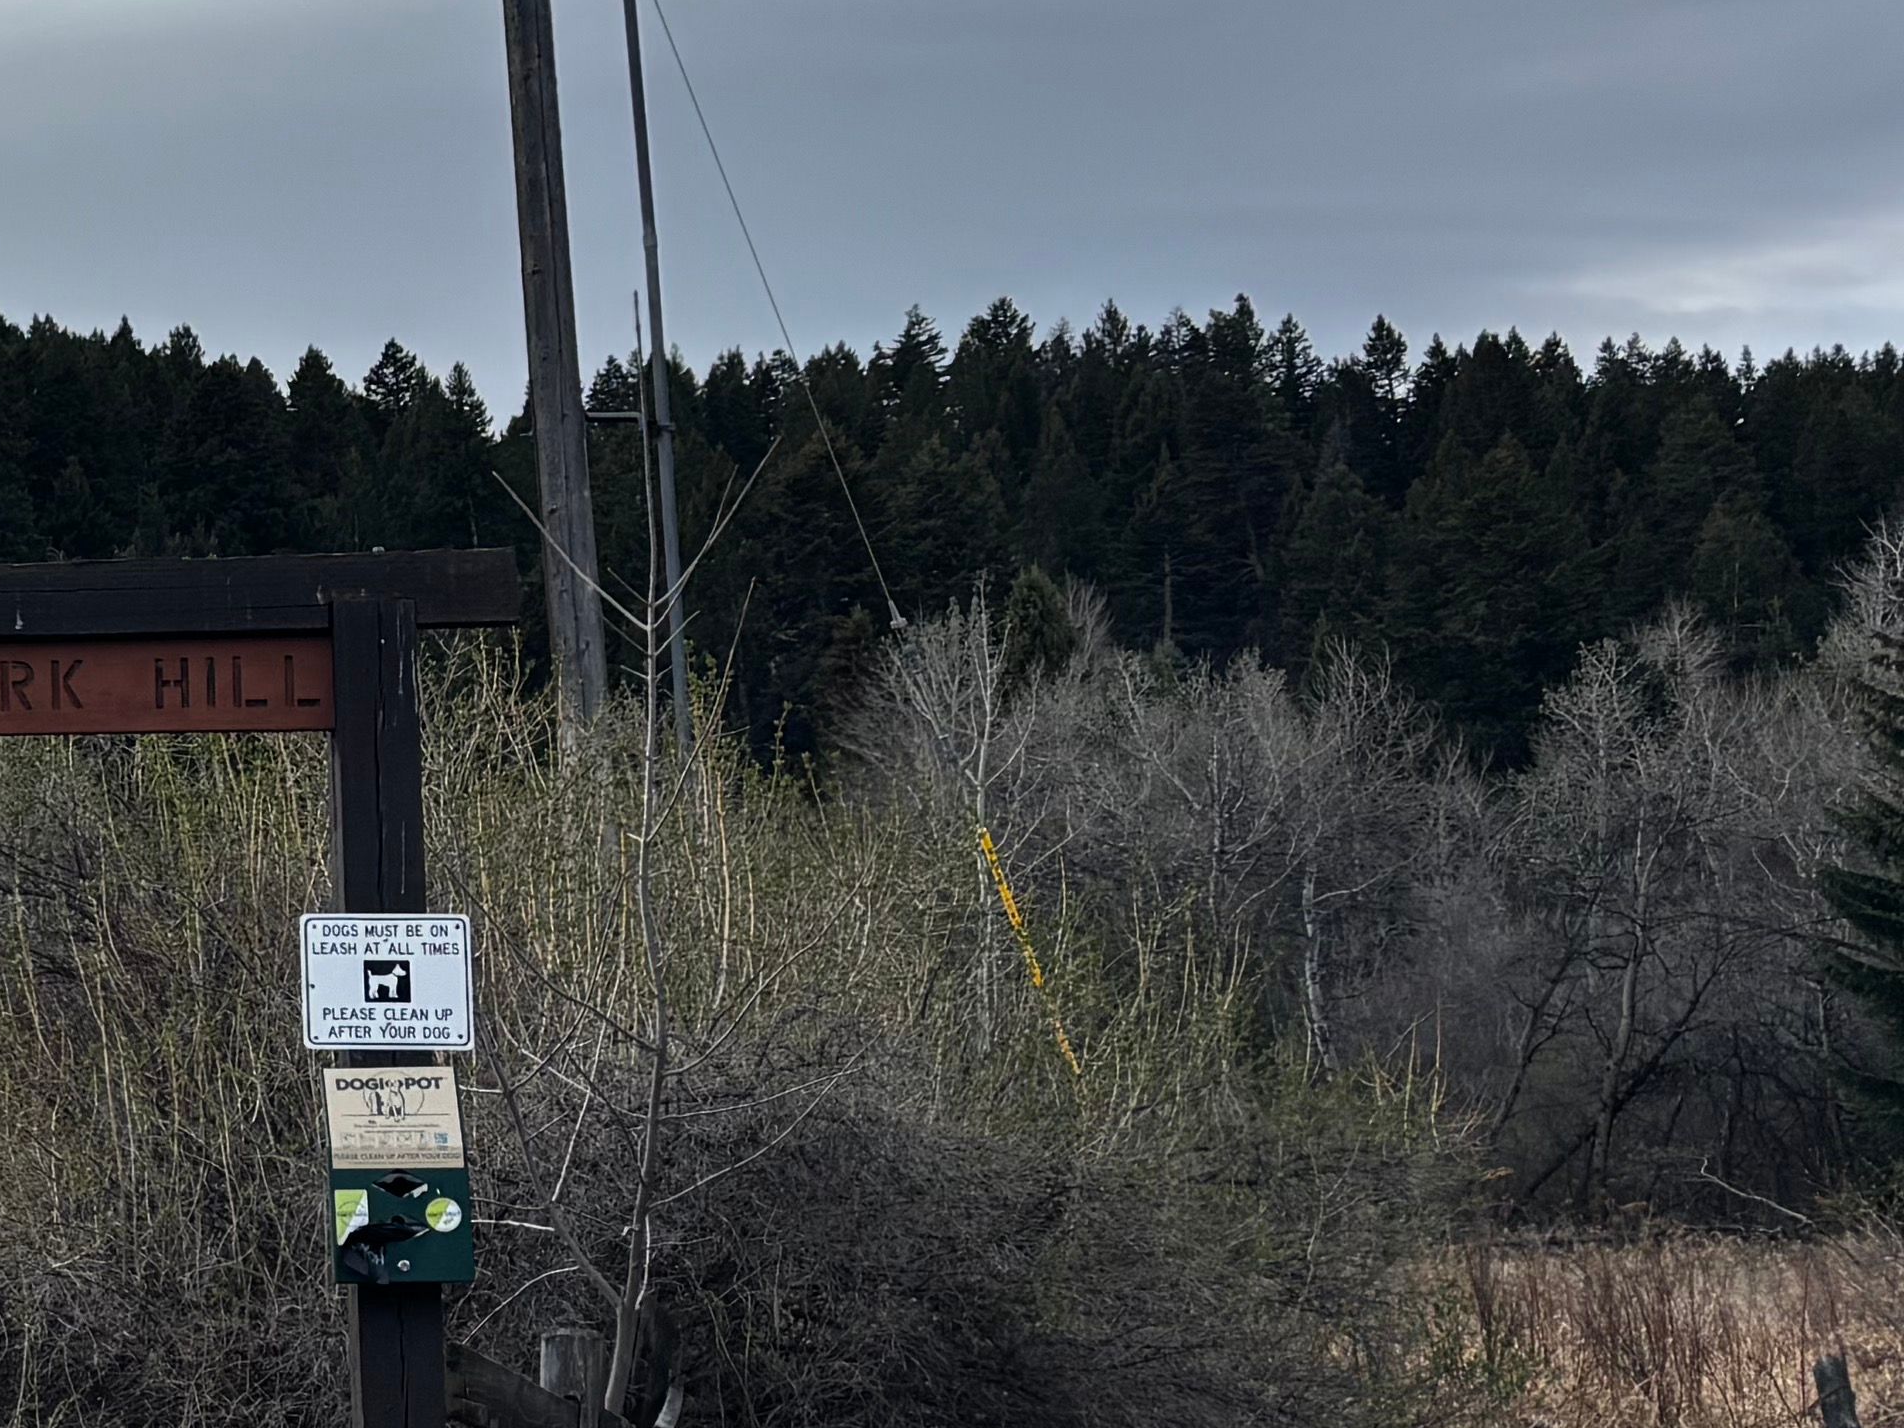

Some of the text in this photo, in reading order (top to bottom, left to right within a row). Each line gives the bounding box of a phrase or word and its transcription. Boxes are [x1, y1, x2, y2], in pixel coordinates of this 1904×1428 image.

[153, 655, 322, 709] HILL
[322, 925, 448, 937] DOGS MUST BE ON
[312, 942, 459, 955] LEASH AT ALL TIMES
[323, 1008, 453, 1021] PLEASE CLEAN UP
[328, 1025, 450, 1039] AFTER YOUR DOG
